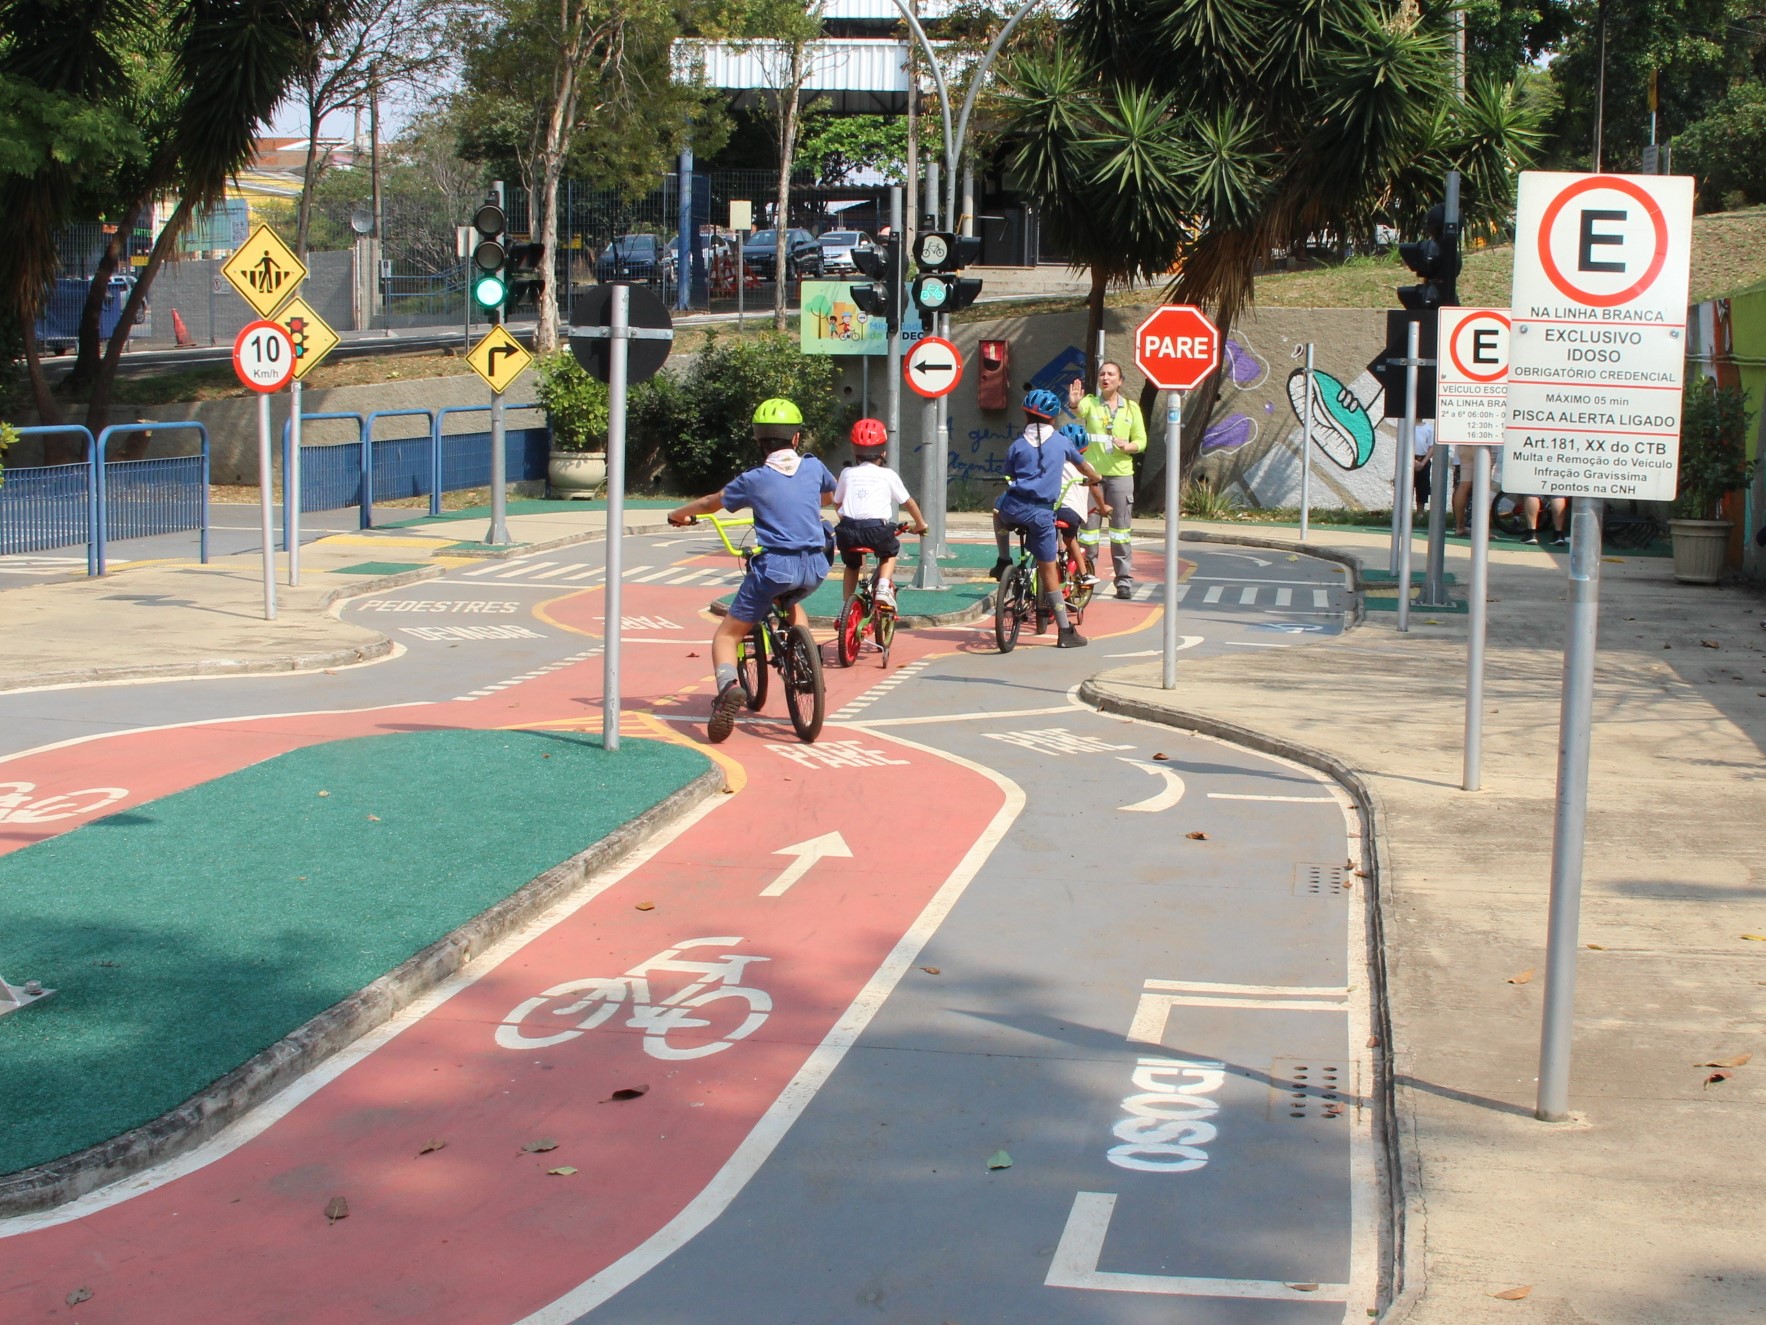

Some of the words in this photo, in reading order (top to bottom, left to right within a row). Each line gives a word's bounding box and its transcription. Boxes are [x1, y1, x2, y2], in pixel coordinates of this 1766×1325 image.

[1578, 209, 1627, 272] E
[1530, 306, 1550, 318] NA
[1554, 308, 1598, 320] LINHA
[1602, 309, 1664, 322] BRANCA
[1545, 329, 1642, 345] EXCLUSIVO
[251, 335, 280, 363] 10
[1145, 335, 1209, 359] PARE
[1473, 329, 1499, 364] E
[1567, 348, 1621, 363] IDOSO
[253, 369, 279, 379] Km/h
[1514, 366, 1596, 379] OBRIGATÓRIO
[1600, 370, 1676, 382] CREDENCIAL
[1442, 384, 1481, 394] VEÍCULO
[1483, 385, 1508, 394] ESCO
[1440, 399, 1454, 407] NA
[1456, 400, 1485, 408] LINHA
[1487, 400, 1507, 408] BRA
[1546, 393, 1591, 405] MÁXIMO
[1594, 396, 1606, 405] 05
[1609, 397, 1629, 406] min
[1512, 409, 1555, 423] PISCA
[1558, 411, 1615, 425] ALERTA
[1619, 414, 1675, 427] LIGADO
[1585, 440, 1606, 452] XX
[1610, 441, 1630, 453] do
[1635, 442, 1666, 454] CTB
[1513, 452, 1543, 462] Multa
[1557, 454, 1610, 466] Remoção
[1613, 457, 1628, 466] do
[1534, 467, 1580, 479] Infração
[1541, 481, 1547, 489] 7
[1550, 482, 1590, 492] pontos
[1593, 485, 1607, 493] na
[1610, 484, 1636, 494] CNH
[357, 600, 520, 614] PEDESTRES
[399, 624, 548, 641] DEVAGAR
[979, 727, 1138, 756] PARE
[763, 740, 912, 770] PARE
[1106, 1058, 1226, 1173] IDOSO
